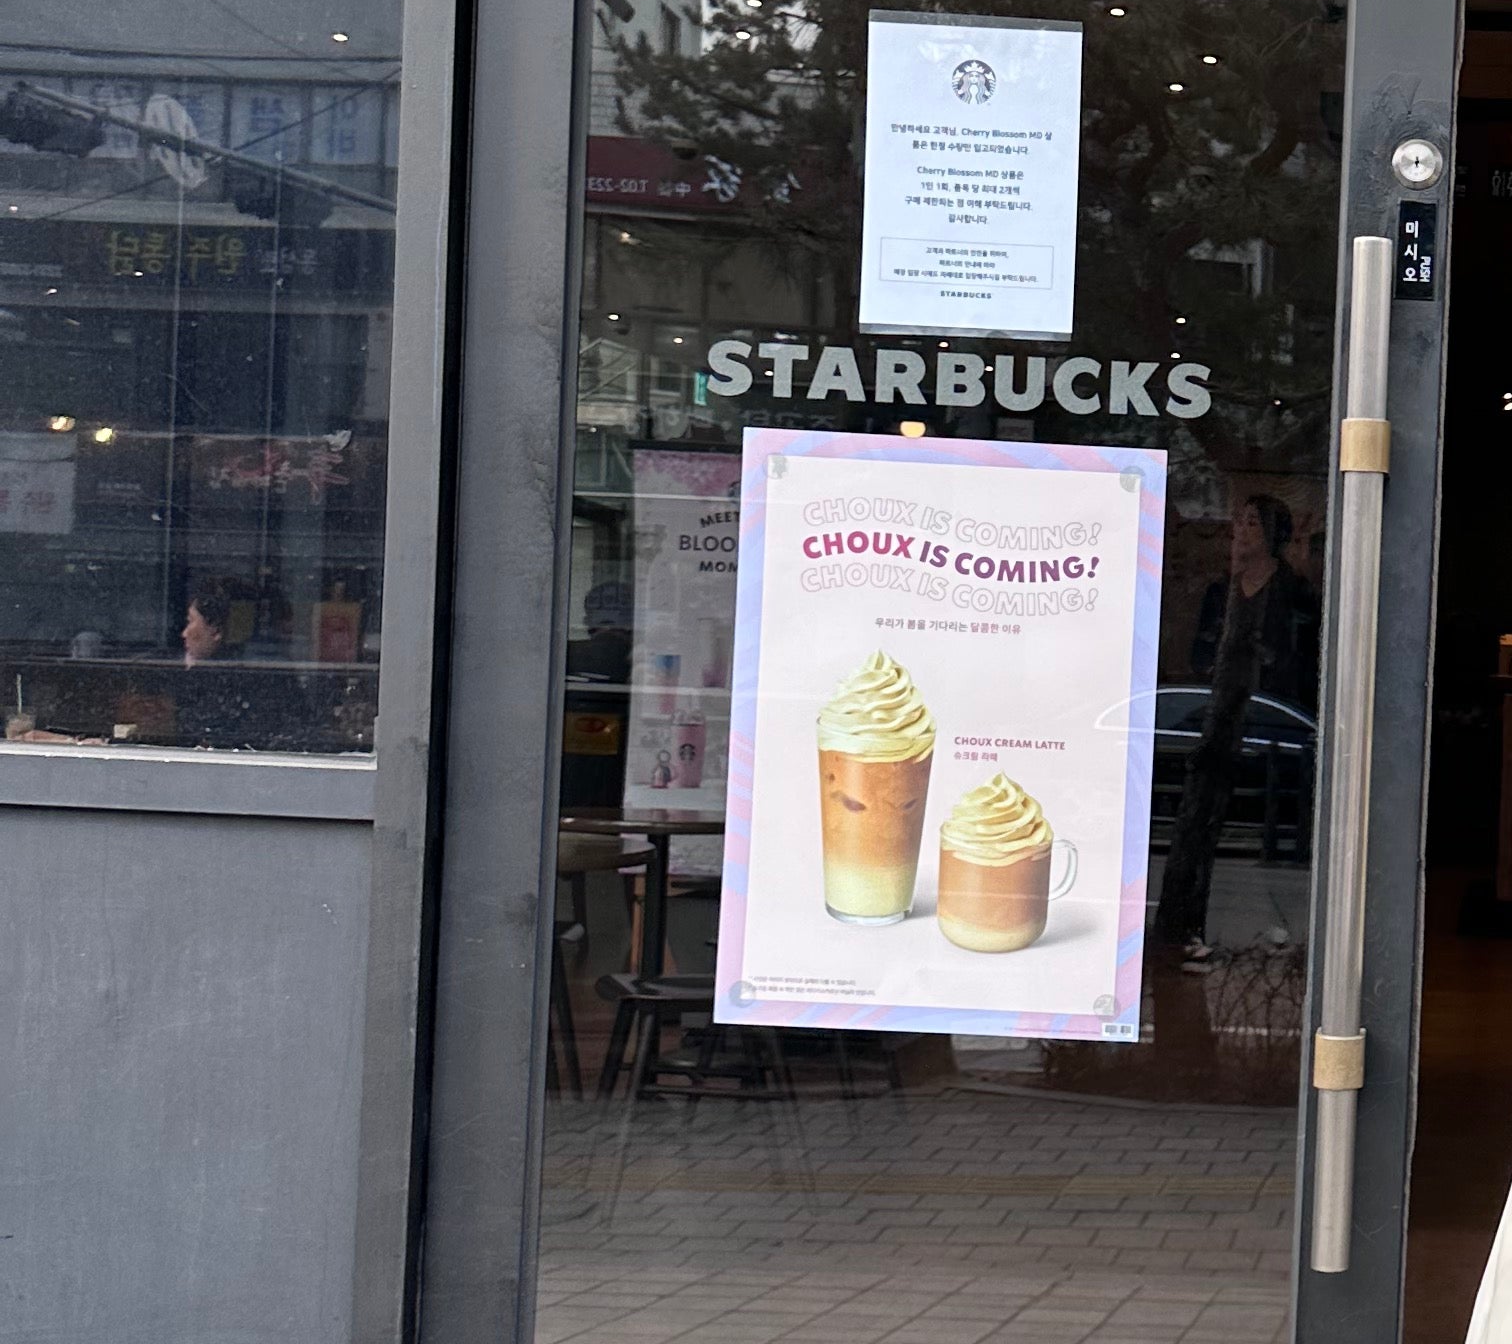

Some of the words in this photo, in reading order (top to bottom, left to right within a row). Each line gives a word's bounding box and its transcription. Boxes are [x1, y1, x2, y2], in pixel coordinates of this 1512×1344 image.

[961, 128, 990, 138] Cherry
[992, 129, 1027, 139] Blossom
[1029, 131, 1043, 139] MD
[917, 166, 946, 176] Cherry
[948, 167, 983, 177] Blossom
[985, 169, 999, 178] MD
[1001, 170, 1024, 180] 상품은
[1419, 256, 1431, 283] PUSH
[940, 290, 992, 300] STARBUCKS
[706, 338, 1213, 420] STARBUCKS
[803, 496, 918, 527] CHOUX
[920, 506, 953, 536] IS
[955, 517, 1102, 551] COMING!
[679, 535, 738, 553] BLOO
[802, 530, 916, 559] CHOUX
[919, 540, 950, 569] IS
[954, 552, 1100, 584] COMING!
[800, 562, 915, 593] CHOUX
[917, 571, 949, 602] IS
[952, 583, 1100, 617] COMING!
[875, 617, 905, 629] 우리가
[907, 618, 926, 631] 봄을
[929, 620, 969, 633] 기다리는
[970, 621, 999, 634] 달콤한
[1002, 623, 1021, 635] 이유
[954, 736, 992, 747] CHOUX
[994, 738, 1032, 749] CREAM
[1034, 740, 1066, 750] LATTE
